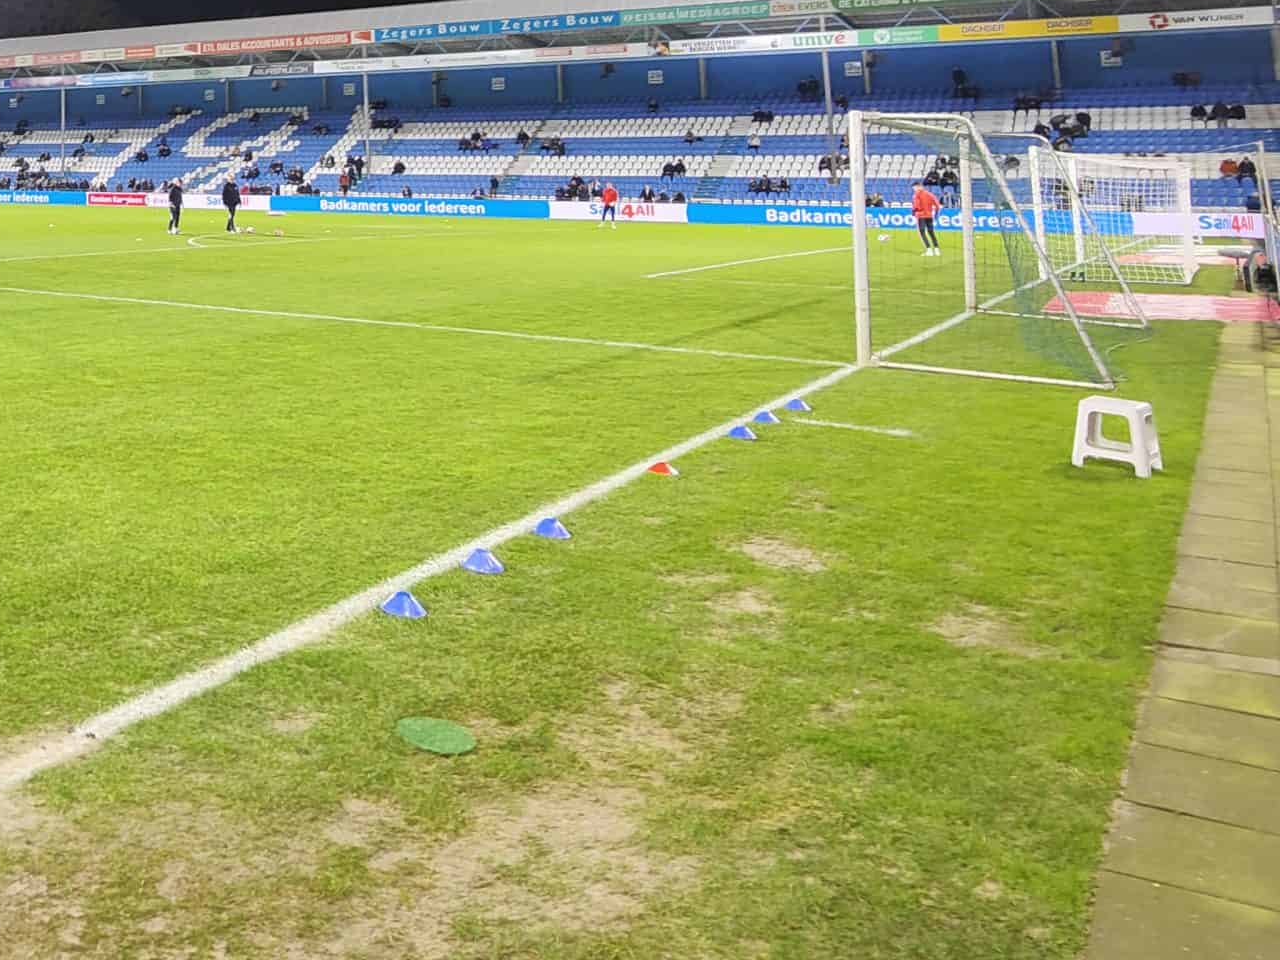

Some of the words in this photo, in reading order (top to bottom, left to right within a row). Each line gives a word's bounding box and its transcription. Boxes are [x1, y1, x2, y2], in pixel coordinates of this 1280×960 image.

[381, 26, 433, 40] Zegers
[438, 22, 480, 34] Bouw
[500, 15, 559, 32] Zegers
[566, 14, 614, 26] Bouw
[320, 199, 389, 212] Badkamers
[391, 202, 421, 213] voor
[424, 200, 485, 214] iedereen
[1199, 215, 1255, 232] Sani4All
